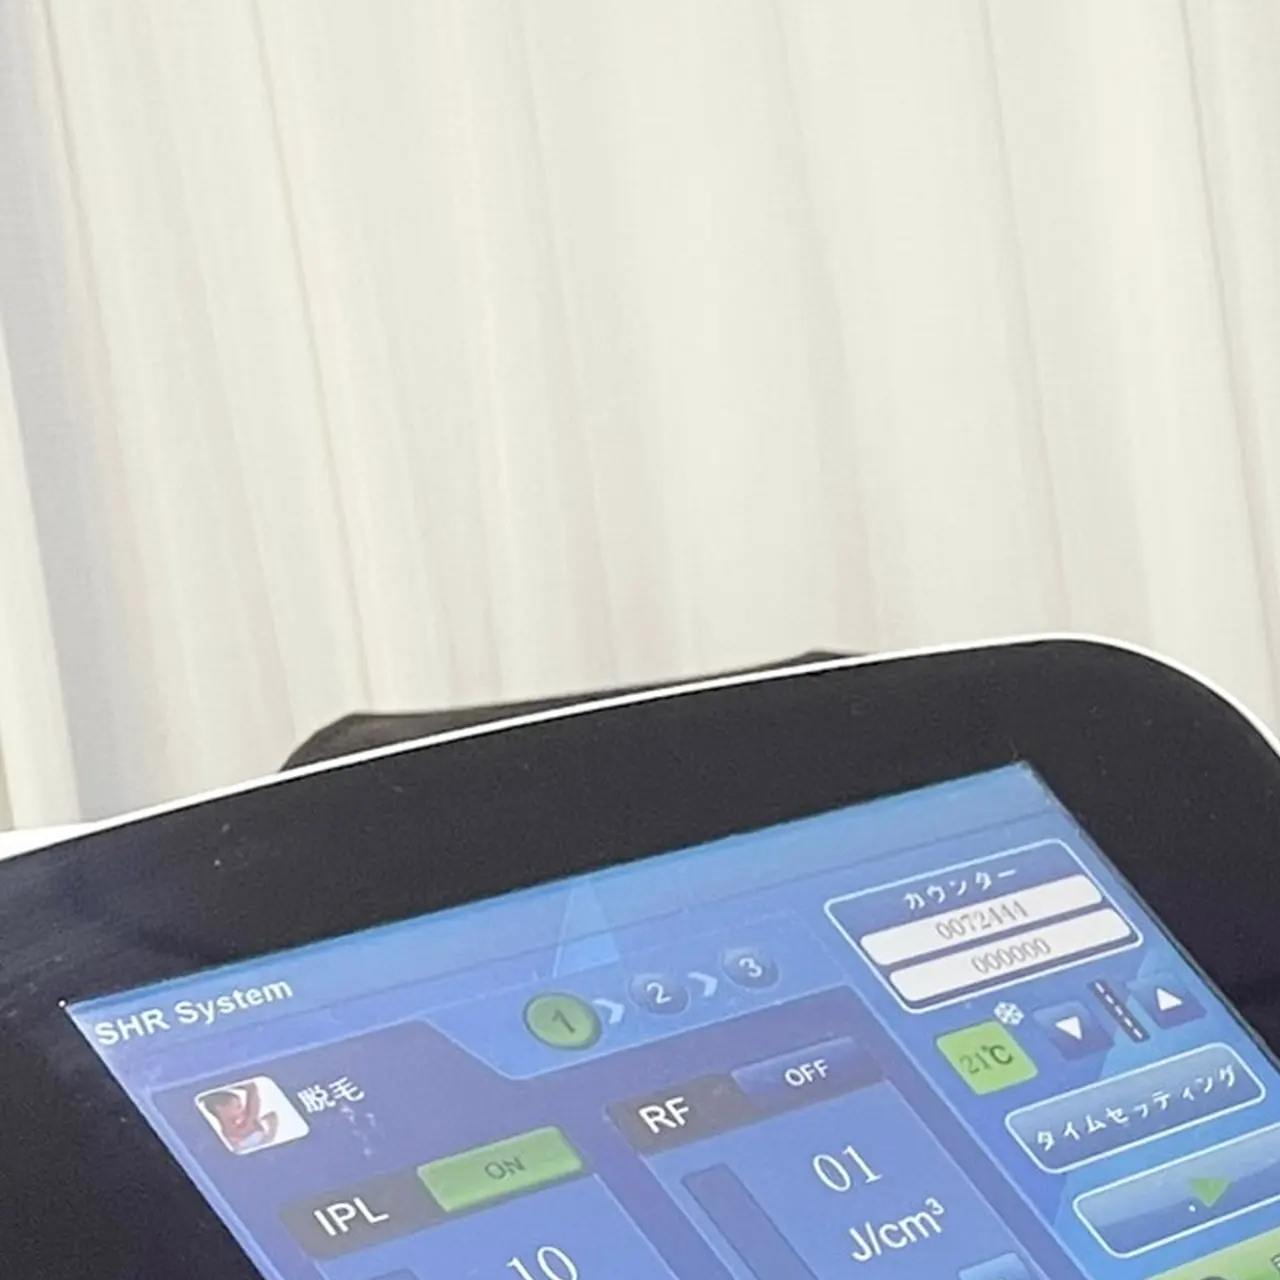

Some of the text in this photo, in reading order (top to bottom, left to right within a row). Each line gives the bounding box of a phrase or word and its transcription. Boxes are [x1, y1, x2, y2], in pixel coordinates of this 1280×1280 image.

[904, 869, 1017, 910] カウンター
[94, 980, 293, 1046] SHR System
[551, 957, 763, 1034] 1 2 3
[297, 1077, 365, 1113] 脱毛
[638, 1058, 829, 1133] RF OFF
[1036, 1064, 1237, 1151] タイムセッティング
[313, 1155, 527, 1237] IPL ON
[813, 1144, 883, 1193] 01
